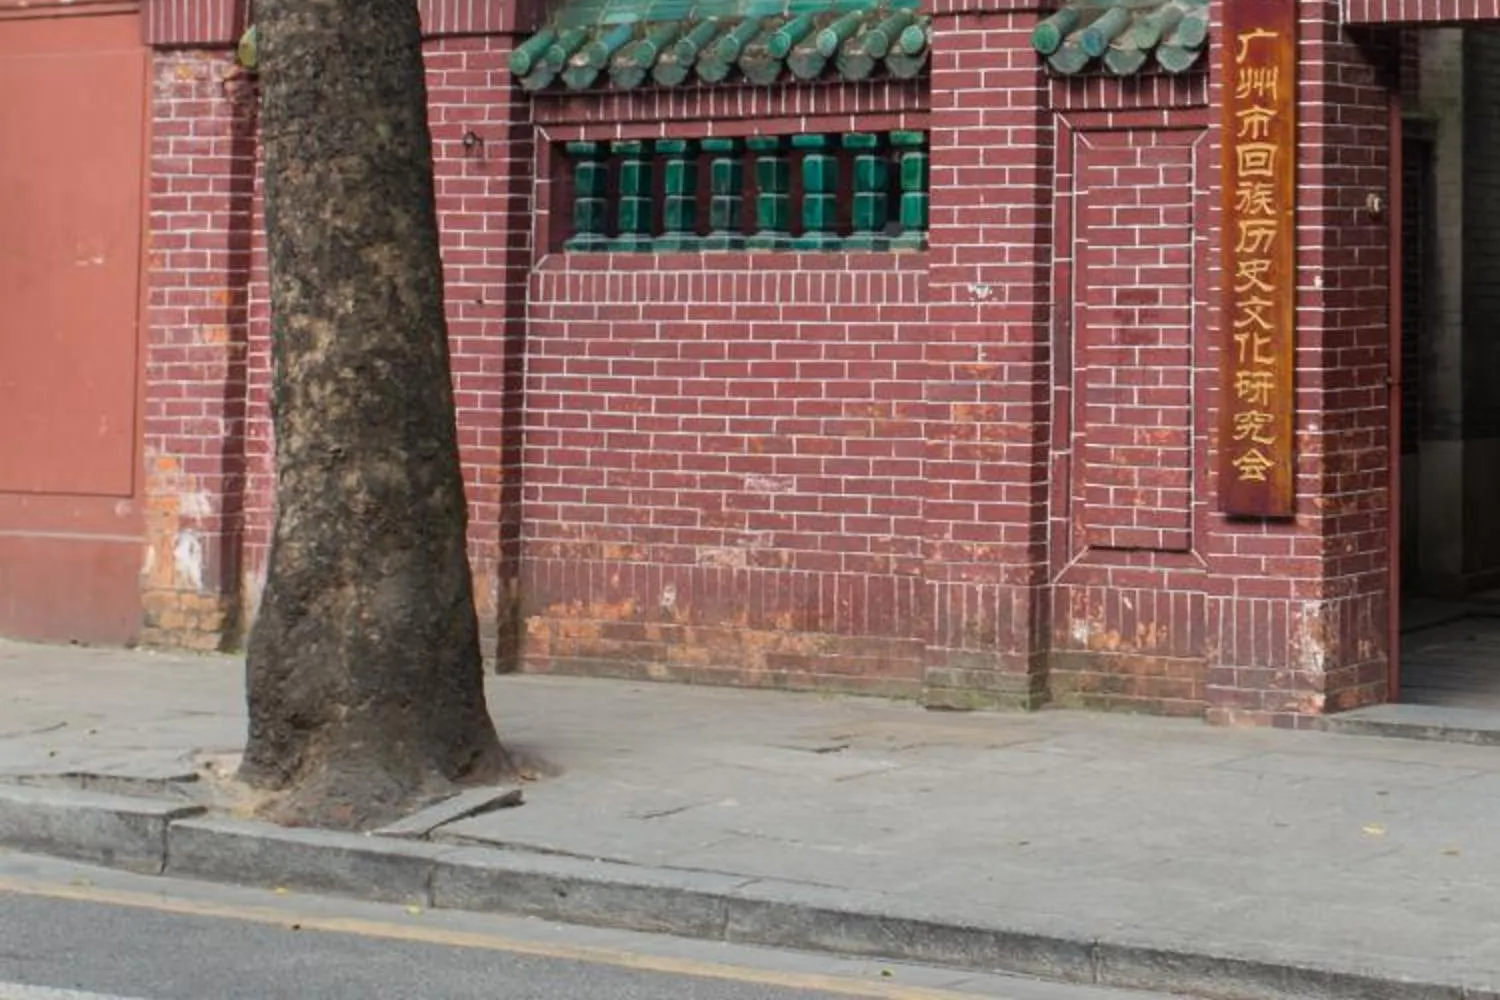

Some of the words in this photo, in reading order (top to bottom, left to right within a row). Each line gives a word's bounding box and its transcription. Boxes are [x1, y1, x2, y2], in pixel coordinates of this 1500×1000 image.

[1232, 27, 1279, 483] 广州市回族历史文化研究会
